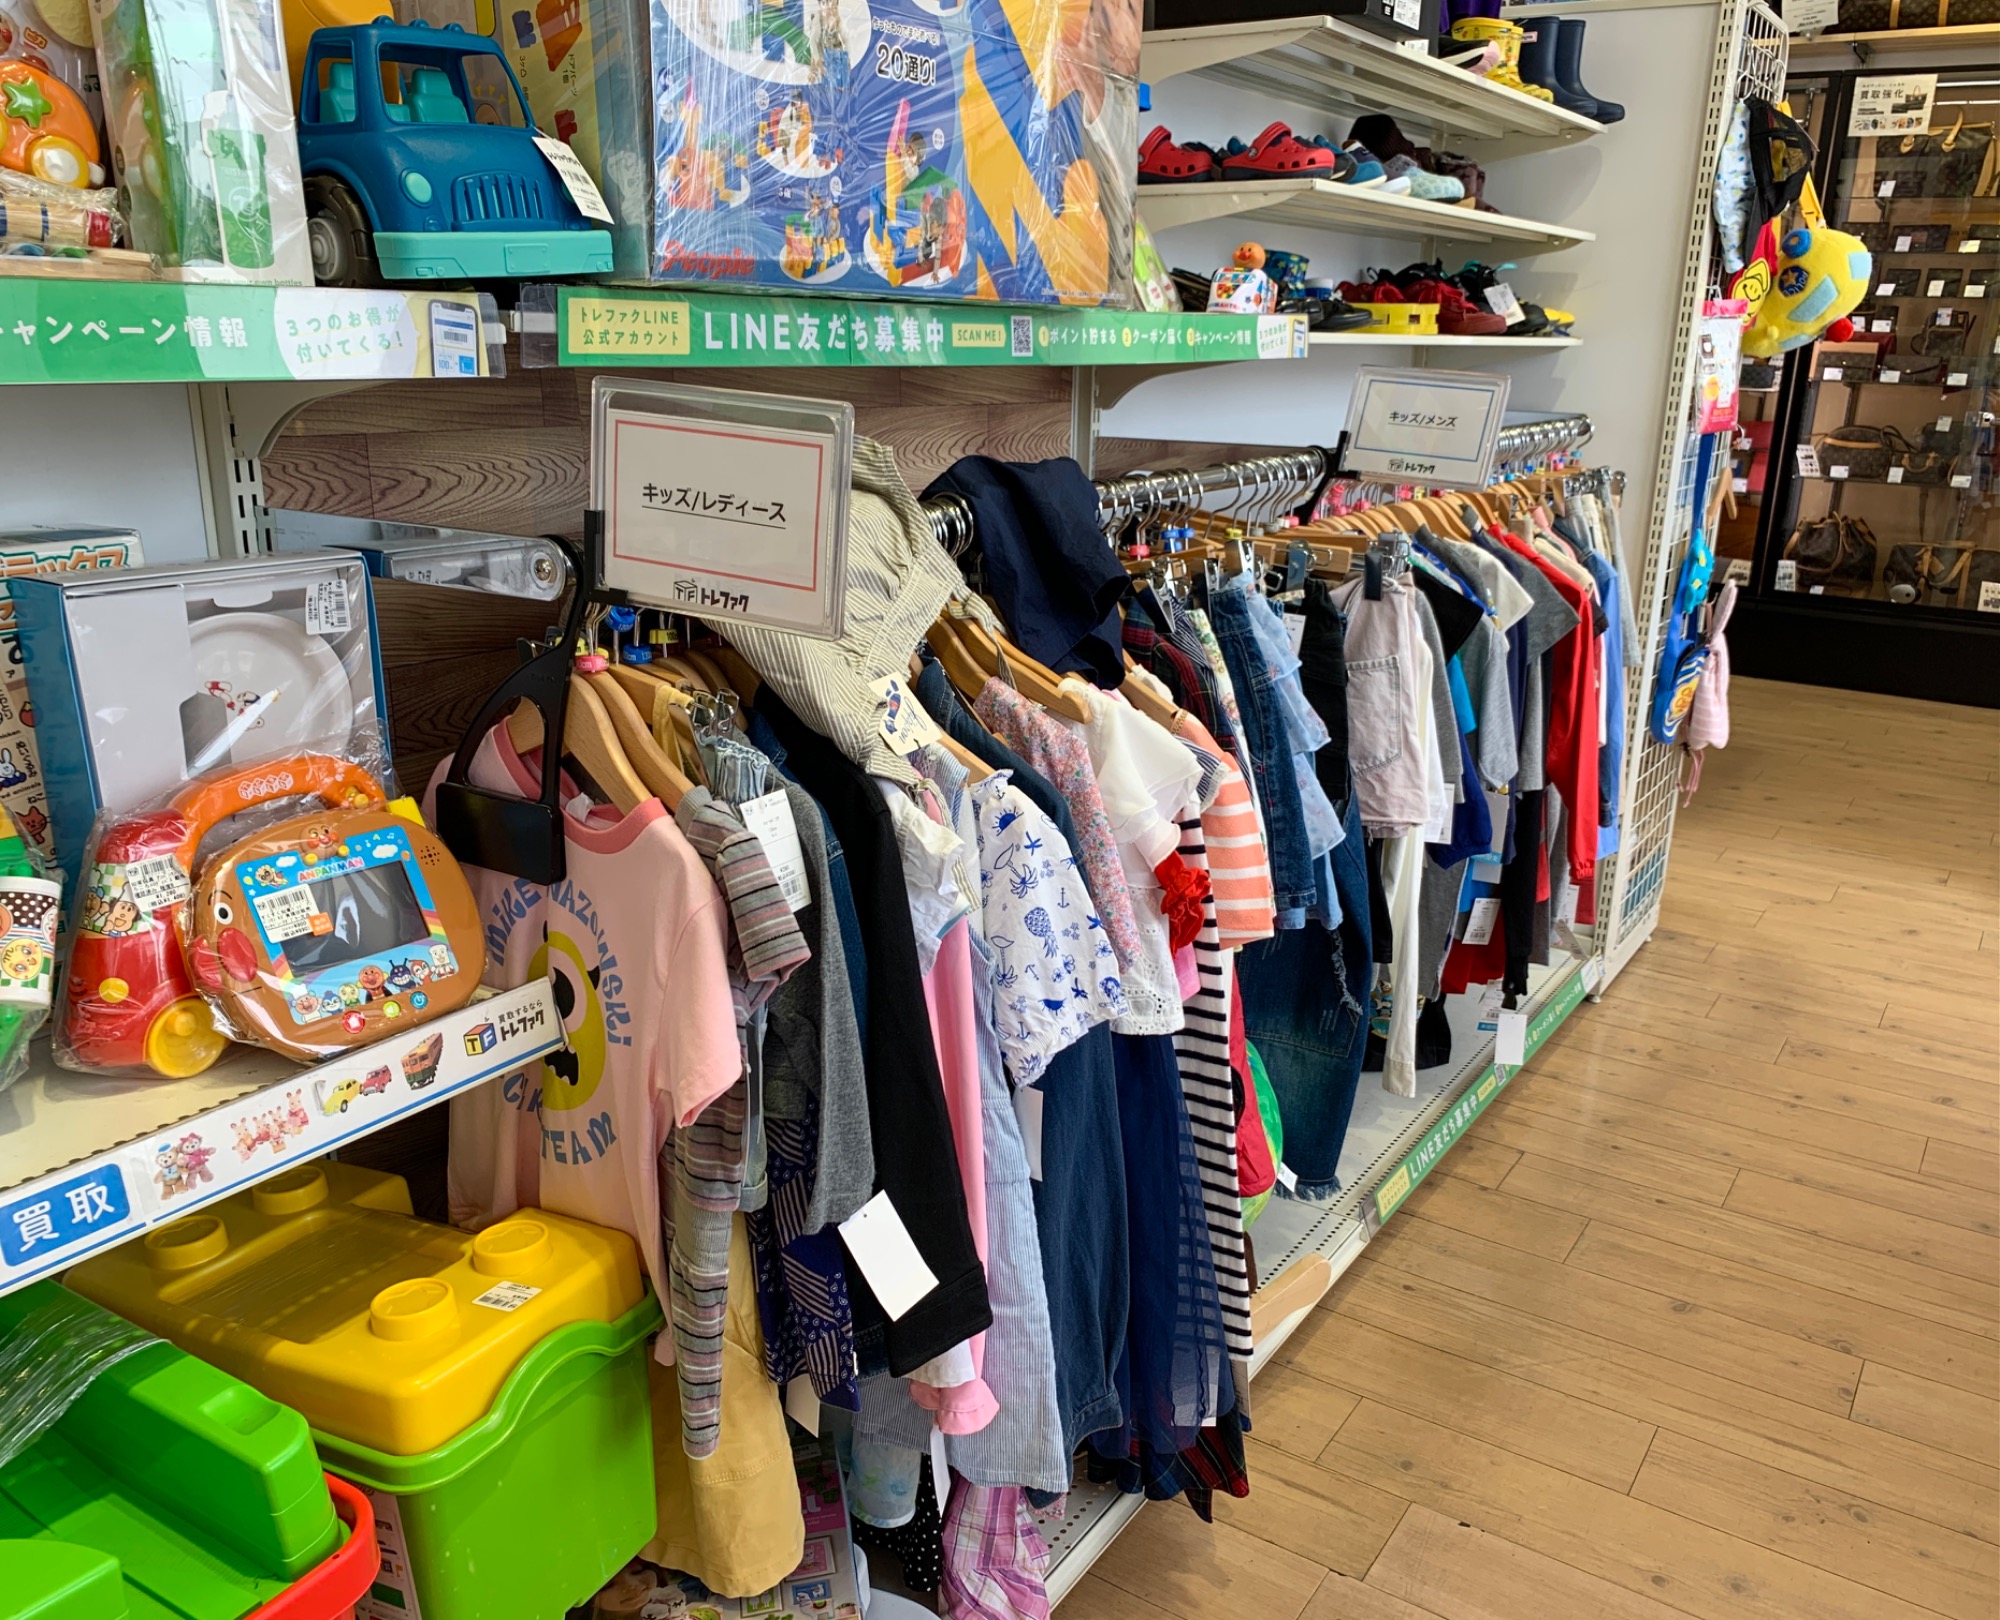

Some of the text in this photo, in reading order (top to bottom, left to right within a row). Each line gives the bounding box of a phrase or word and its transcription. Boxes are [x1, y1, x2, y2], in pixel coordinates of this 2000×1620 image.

[877, 43, 936, 85] 20通り!
[1860, 89, 1904, 99] 買取強化
[286, 304, 400, 337] 3つのお得が
[581, 307, 679, 324] トレファクLINE
[0, 315, 248, 348] ャンペーン情報
[583, 329, 679, 346] 公式アカウント
[705, 312, 944, 352] LINE友だち募集中
[957, 329, 982, 341] SCAN
[296, 330, 403, 364] 付いてくる!
[1389, 411, 1458, 427] キッズ/メンズ
[1405, 462, 1435, 474] トレファク
[642, 483, 786, 522] キッズ/レディース
[701, 587, 750, 612] トレファク
[298, 857, 365, 882] ANPANMAN
[498, 1000, 543, 1024] 買取するなら
[500, 1009, 545, 1041] トレファク
[541, 1111, 617, 1165] TEAM
[12, 1182, 115, 1252] 買取
